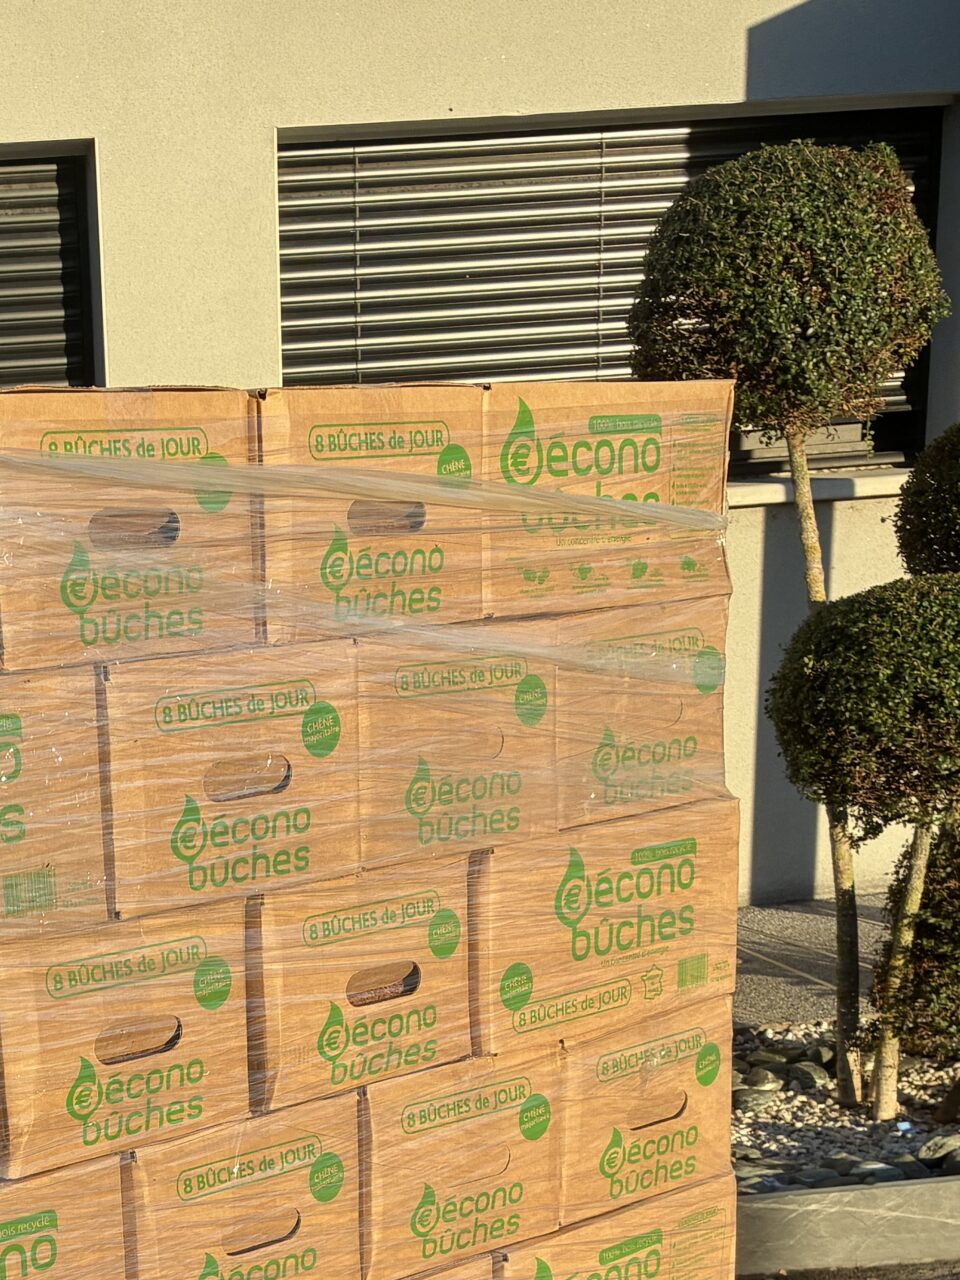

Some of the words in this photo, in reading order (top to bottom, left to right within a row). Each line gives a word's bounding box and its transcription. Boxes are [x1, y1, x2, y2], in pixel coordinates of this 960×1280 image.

[64, 438, 131, 459] BÛCHES
[136, 440, 154, 458] de
[159, 437, 201, 459] JOUR
[315, 436, 325, 452] 8
[329, 428, 385, 452] BÛCHES
[389, 434, 403, 450] de
[407, 430, 444, 452] JOUR
[546, 436, 661, 477] écono
[442, 459, 466, 476] CHÊNE
[95, 565, 203, 601] écono
[356, 546, 444, 580] écono
[334, 582, 442, 622] bûches
[79, 604, 203, 647] bûches
[668, 636, 699, 654] JOUR
[401, 675, 410, 690] 8
[412, 667, 466, 689] BÛCHES
[470, 670, 485, 684] de
[488, 663, 522, 685] JOUR
[162, 706, 173, 724] 8
[178, 693, 241, 723] BÛCHES
[247, 694, 265, 713] de
[269, 689, 309, 715] JOUR
[307, 715, 334, 734] CHÊNE
[621, 735, 698, 770] écono
[439, 771, 522, 806] écono
[209, 806, 311, 848] écono
[418, 804, 520, 846] bûches
[187, 844, 310, 891] bûches
[594, 859, 694, 908] écono
[309, 923, 319, 940] 8
[322, 908, 378, 938] BÛCHES
[381, 908, 398, 925] de
[400, 898, 435, 926] JOUR
[571, 904, 694, 962] bûches
[52, 973, 63, 991] 8
[67, 952, 132, 989] BÛCHES
[137, 954, 156, 973] de
[160, 945, 201, 973] JOUR
[351, 1003, 438, 1049] écono
[518, 1012, 527, 1027] 8
[530, 995, 577, 1024] BÛCHES
[581, 995, 595, 1010] de
[597, 986, 628, 1010] JOUR
[329, 1036, 438, 1086] bûches
[601, 1063, 609, 1076] 8
[611, 1049, 657, 1074] BÛCHES
[660, 1045, 673, 1059] de
[674, 1034, 702, 1057] JOUR
[104, 1058, 205, 1105] écono
[81, 1093, 204, 1147] bûches
[406, 1112, 416, 1128] 8
[418, 1095, 471, 1125] BÛCHES
[475, 1095, 490, 1110] de
[493, 1085, 527, 1109] JOUR
[627, 1125, 699, 1165] écono
[183, 1177, 194, 1194] 8
[196, 1159, 255, 1191] BÛCHES
[259, 1157, 276, 1174] de
[278, 1145, 316, 1172] JOUR
[609, 1155, 697, 1200] bûches
[440, 1183, 524, 1224] écono
[421, 1212, 521, 1259] bûches
